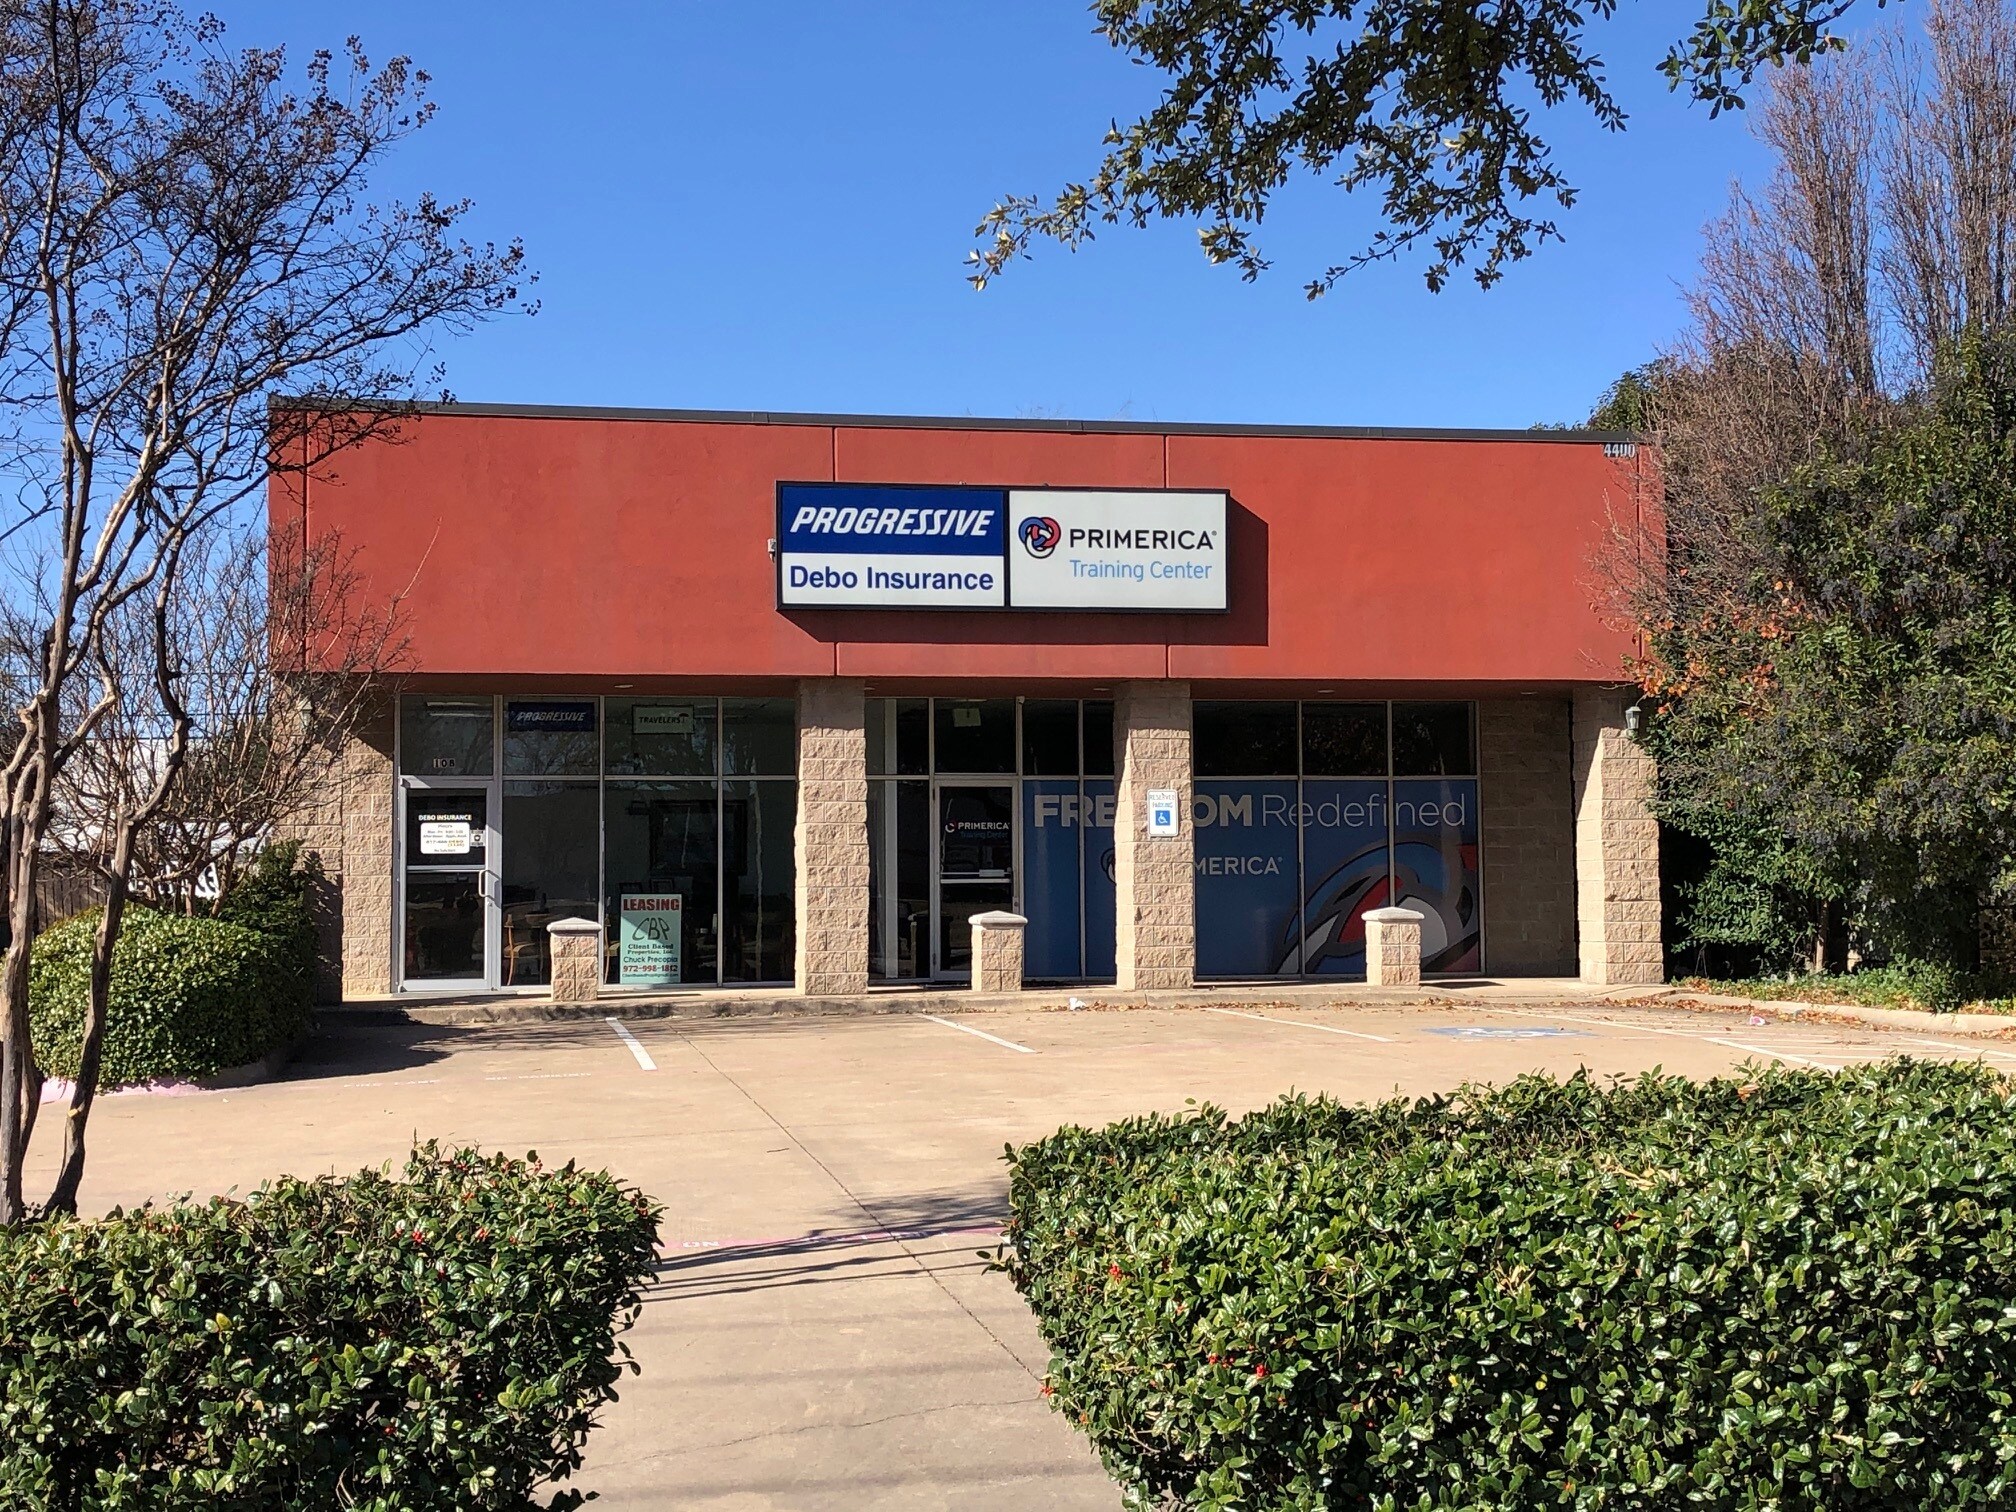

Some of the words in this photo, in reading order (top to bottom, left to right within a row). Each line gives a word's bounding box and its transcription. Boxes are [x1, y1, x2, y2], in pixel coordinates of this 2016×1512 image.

[1604, 443, 1636, 458] 4400
[790, 506, 995, 537] PROGRESSIVE
[1069, 528, 1214, 550] PRIMERICA
[790, 565, 858, 589] Debo
[866, 566, 994, 590] Insurance
[1069, 559, 1144, 582] Training
[1150, 560, 1212, 579] Center
[516, 711, 586, 722] PROGRESSIVE
[638, 715, 681, 724] TRAVELERS
[1034, 794, 1252, 827] FREOM
[1262, 793, 1465, 827] Redefined
[957, 822, 1010, 830] PRIMERICA
[1193, 855, 1283, 876] MERICA
[624, 899, 679, 910] LEASING
